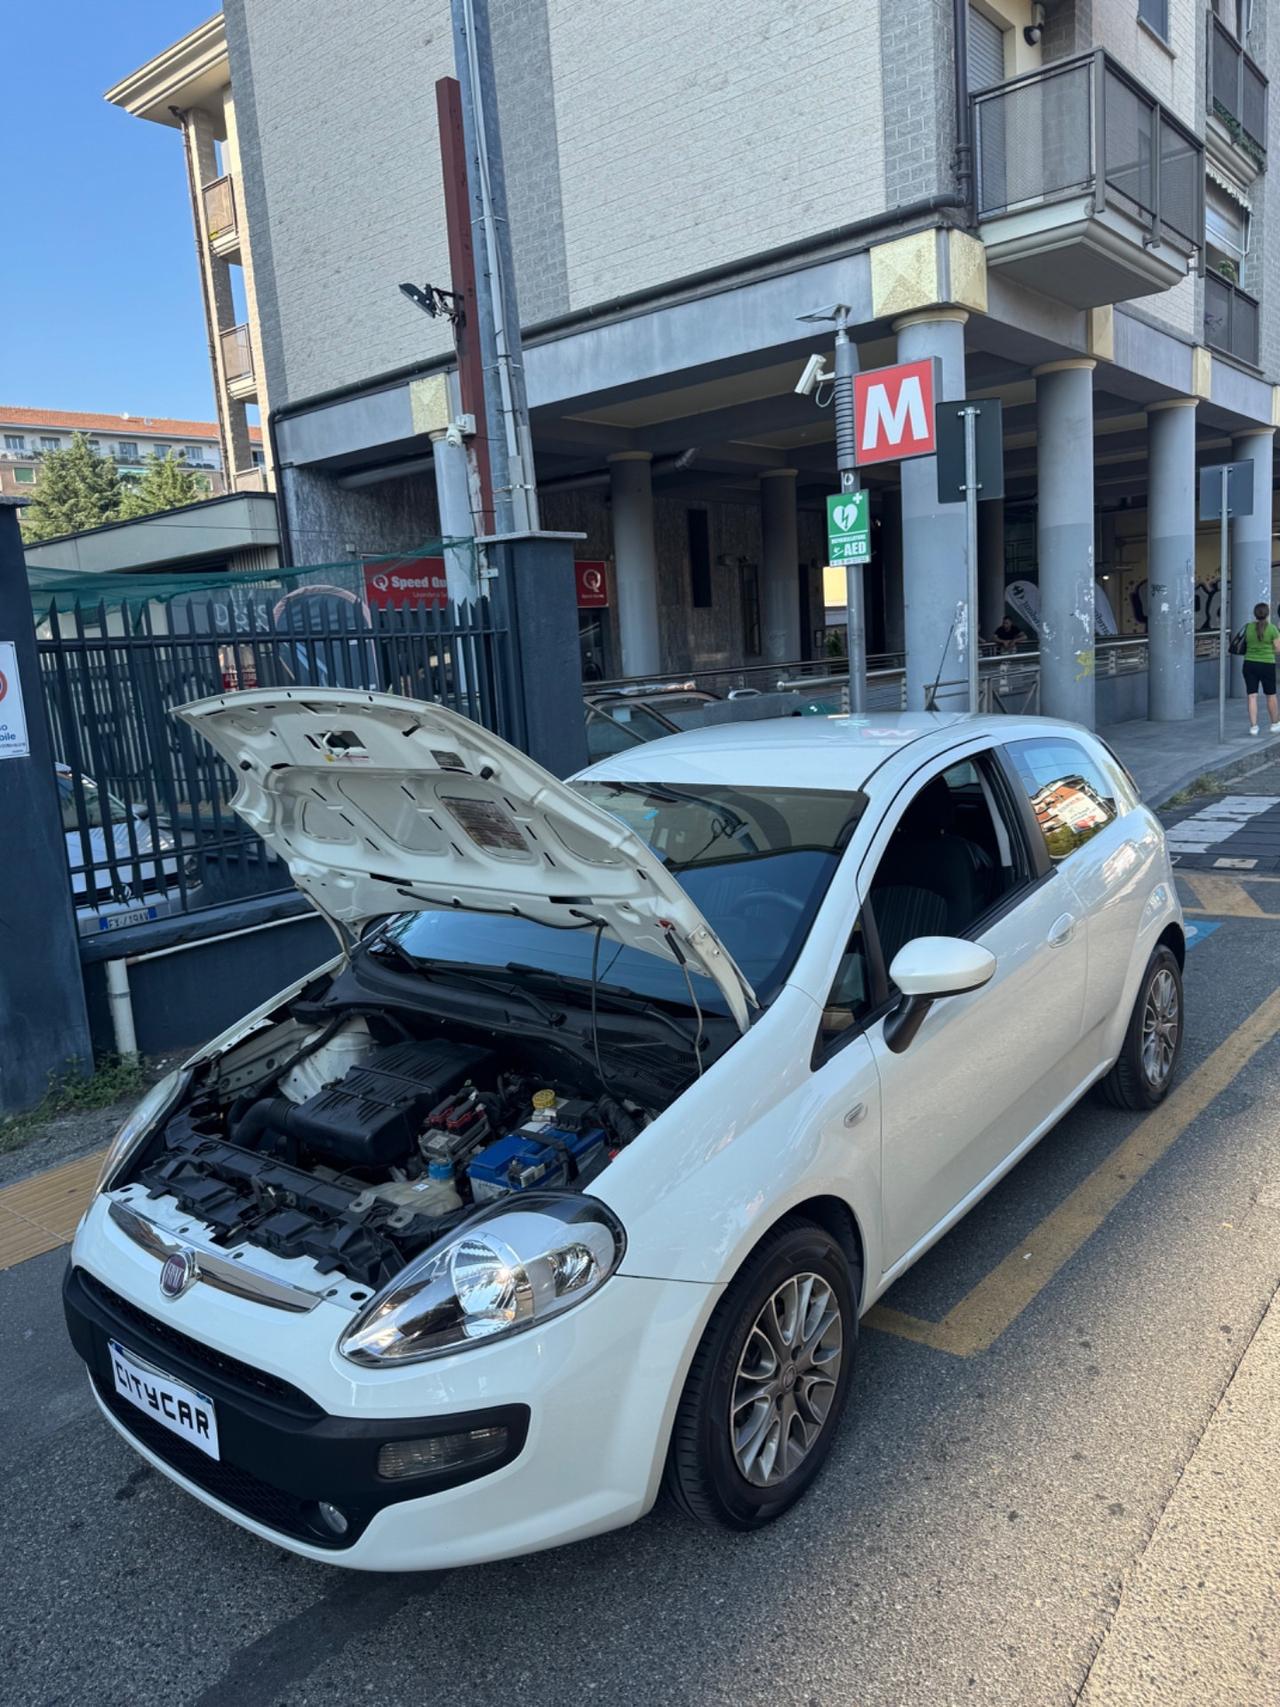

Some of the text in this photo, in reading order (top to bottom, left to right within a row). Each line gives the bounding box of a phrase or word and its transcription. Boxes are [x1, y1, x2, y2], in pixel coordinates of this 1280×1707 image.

[862, 376, 929, 451] M
[843, 541, 867, 557] AED
[391, 576, 430, 591] Speed
[115, 1360, 210, 1440] CITYCAR
